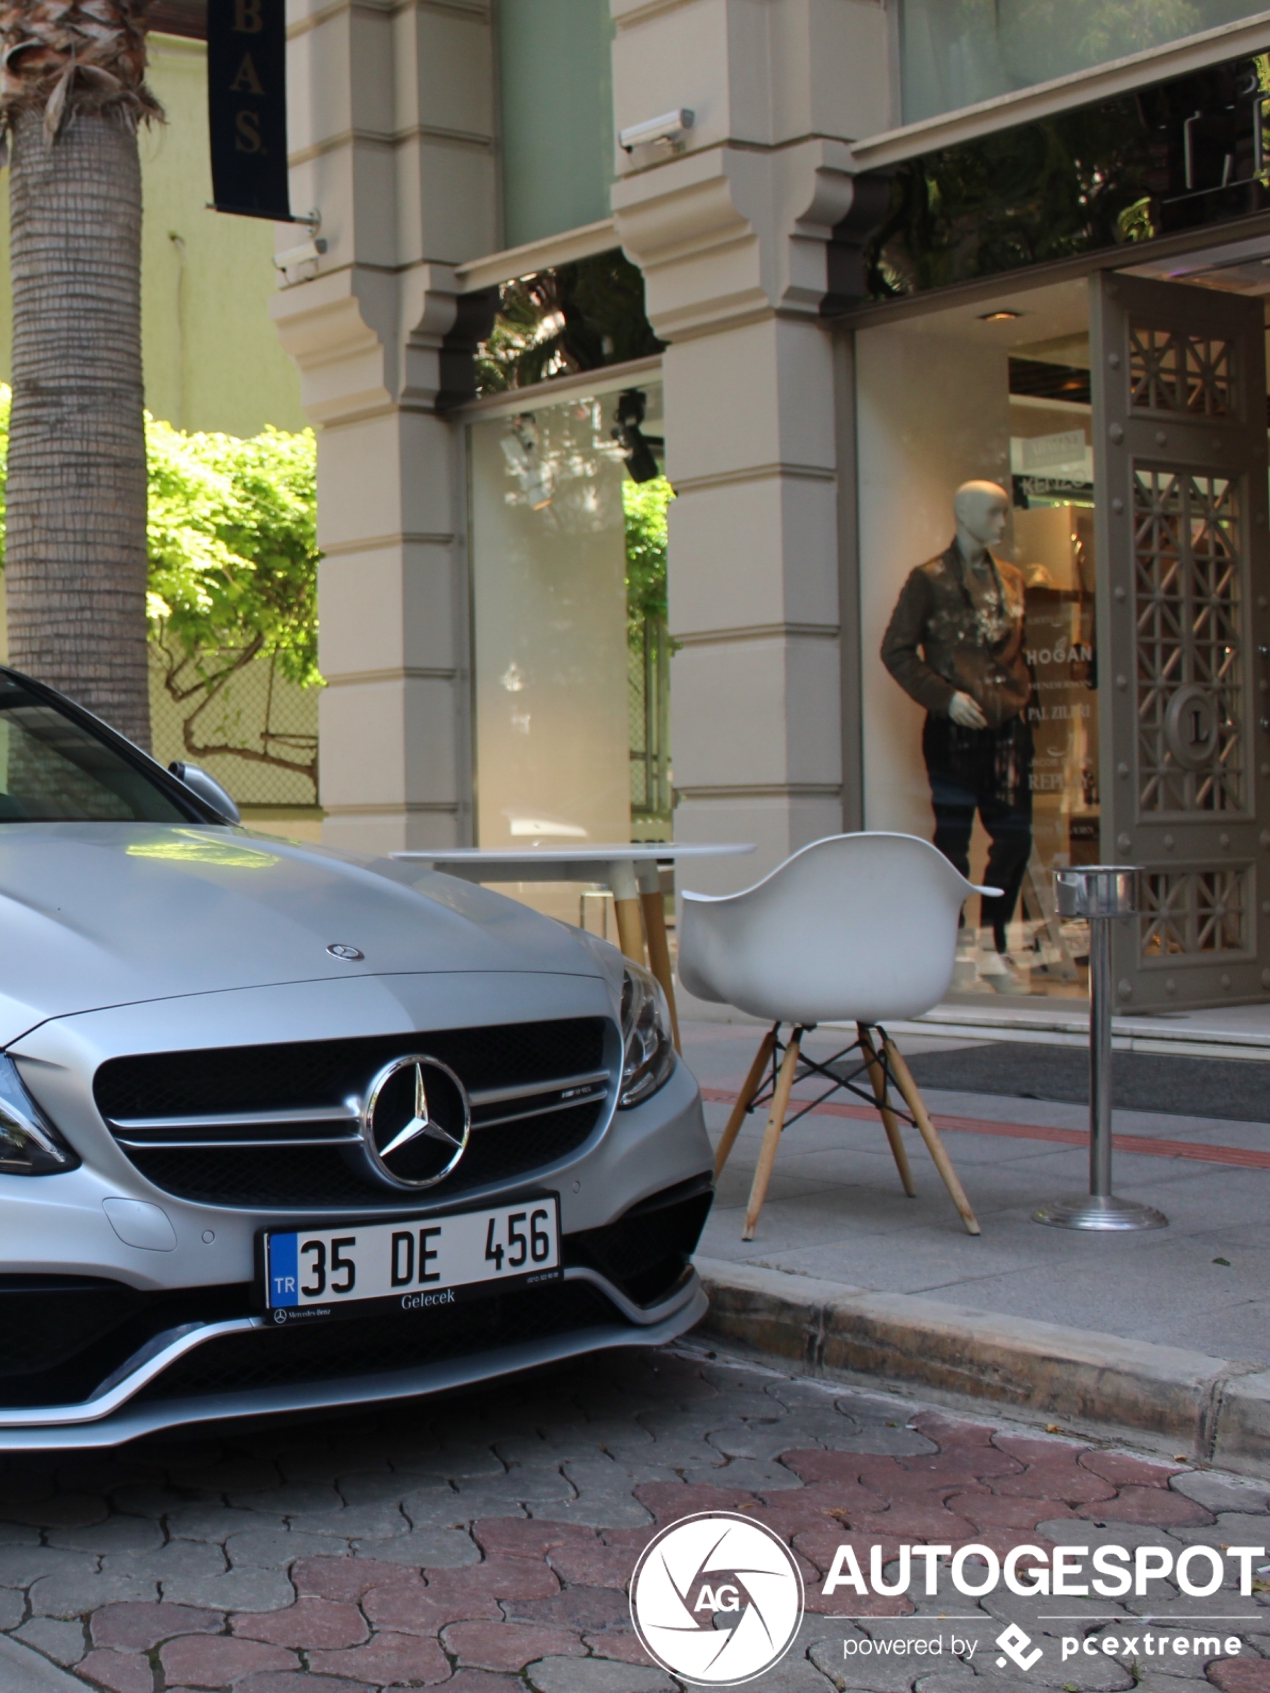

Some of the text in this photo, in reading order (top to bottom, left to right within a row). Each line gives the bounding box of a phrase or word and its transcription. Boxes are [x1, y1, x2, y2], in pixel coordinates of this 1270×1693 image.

[1026, 646, 1092, 666] HOGAN
[1027, 707, 1049, 721] PAL
[300, 1209, 549, 1297] 35 DE 456
[274, 1277, 295, 1294] TR
[401, 1288, 455, 1310] Gelecek
